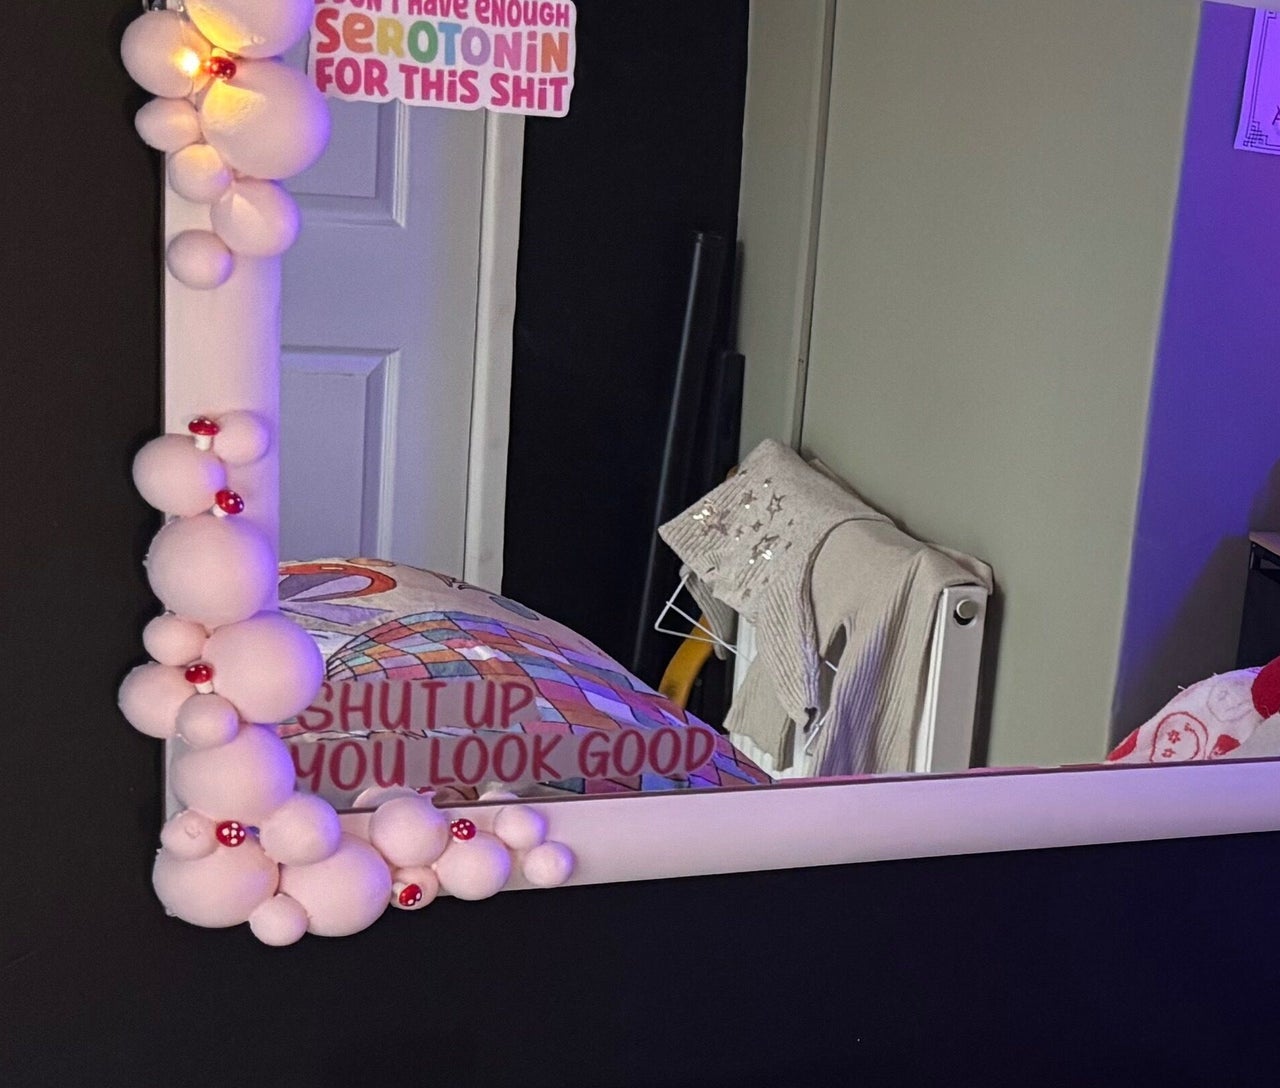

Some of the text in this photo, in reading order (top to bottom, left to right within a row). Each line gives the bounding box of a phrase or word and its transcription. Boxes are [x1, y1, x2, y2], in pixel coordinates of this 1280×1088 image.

[315, 57, 389, 97] FOR
[297, 680, 536, 732] SHUT UP
[290, 725, 715, 793] YOU LOOK GOOD
